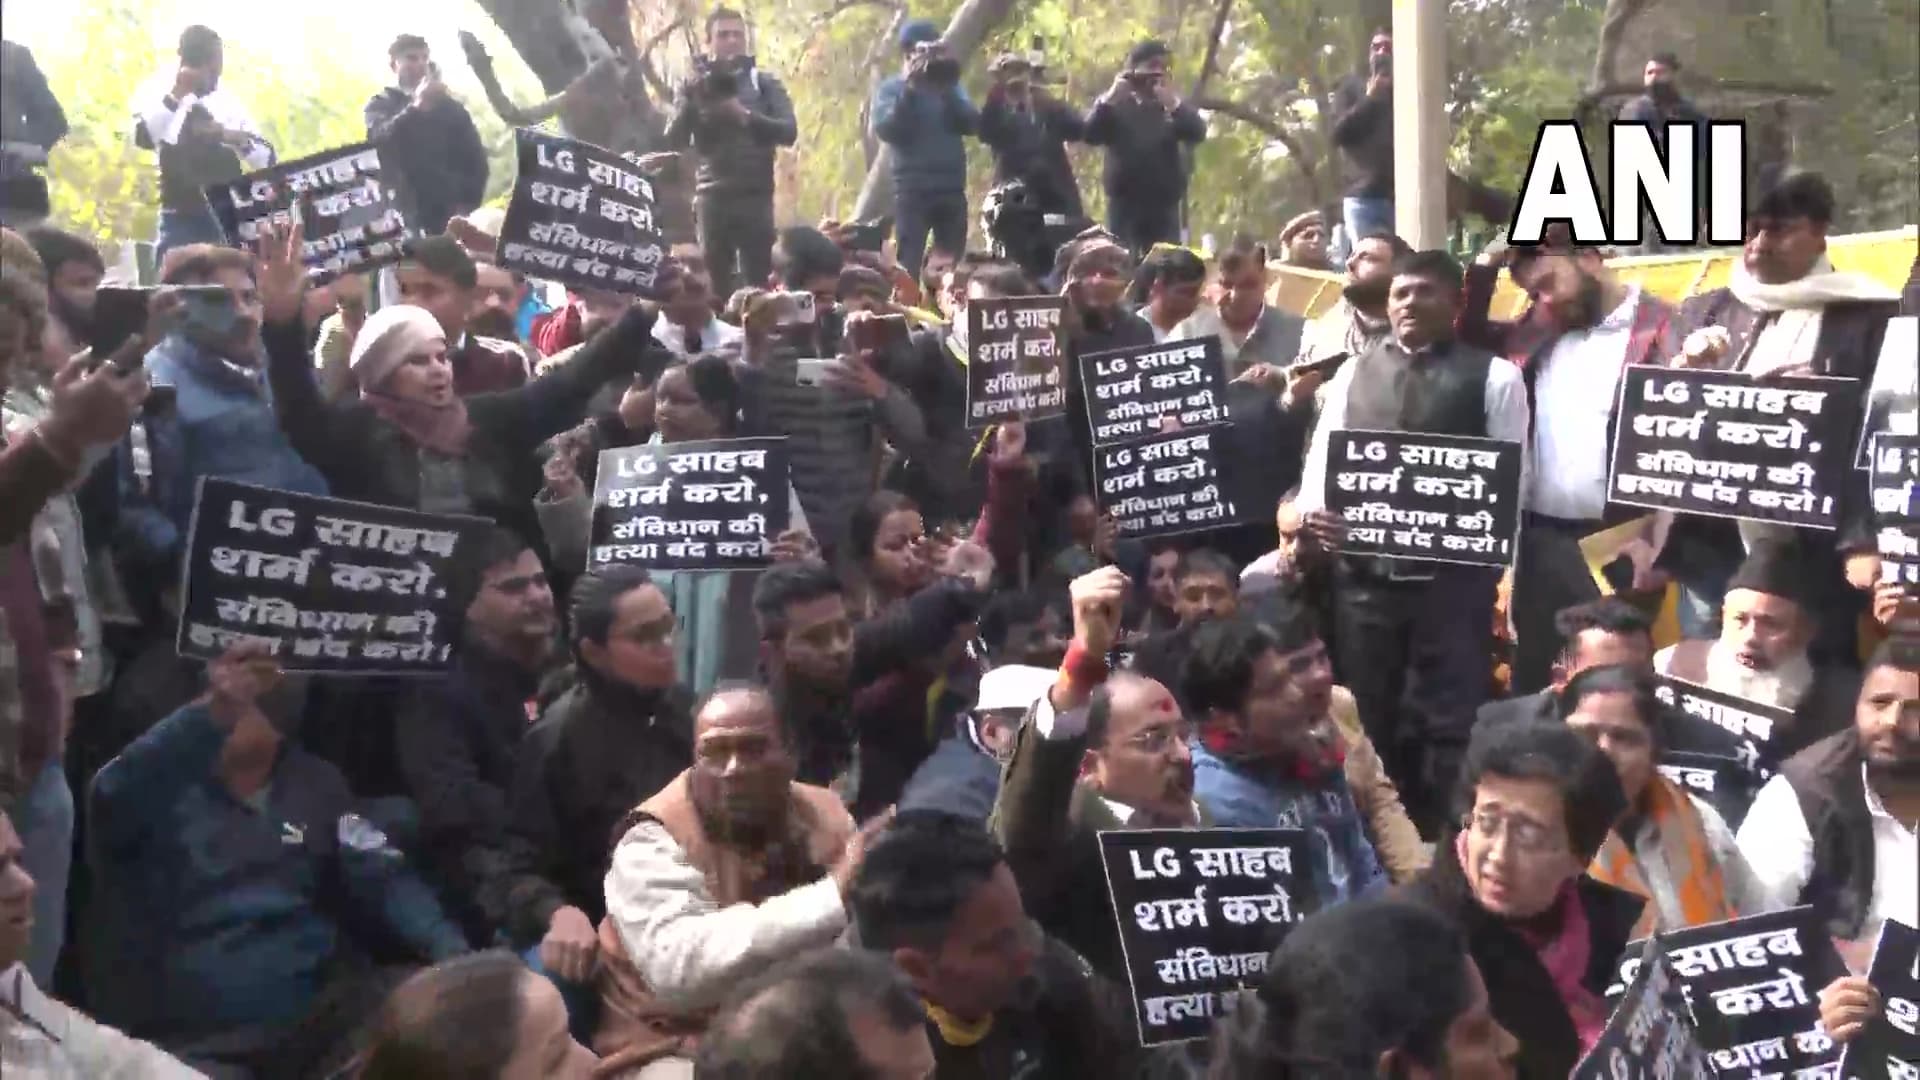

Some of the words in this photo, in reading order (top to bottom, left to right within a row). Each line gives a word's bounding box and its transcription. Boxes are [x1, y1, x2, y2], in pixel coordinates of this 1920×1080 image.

[537, 144, 576, 174] LG
[586, 158, 655, 203] साहब
[531, 182, 593, 214] शर्म
[981, 309, 1008, 331] LG
[1013, 308, 1061, 328] साहब
[978, 333, 1019, 362] शर्म
[1095, 358, 1128, 376] LG
[1134, 344, 1206, 369] साहब
[1096, 373, 1142, 399] शर्म
[1643, 379, 1690, 404] LG
[1702, 384, 1828, 414] साहब
[1106, 398, 1182, 420] संविधान
[1187, 389, 1213, 406] की
[1633, 410, 1709, 440] शर्म
[617, 455, 657, 477] LG
[668, 450, 767, 473] साहब
[1105, 449, 1132, 469] LG
[1138, 434, 1210, 461] साहब
[1347, 441, 1387, 461] LG
[1400, 444, 1501, 470] साहब
[1103, 465, 1146, 493] शर्म
[1337, 466, 1405, 493] शर्म
[1636, 449, 1759, 481] संविधान
[1766, 462, 1815, 487] की
[608, 477, 673, 507] शर्म
[683, 475, 768, 505] करो,
[1110, 493, 1186, 517] संविधान
[1192, 484, 1218, 503] की
[1617, 473, 1685, 497] हत्या
[1691, 479, 1741, 504] बंद
[229, 500, 296, 536] LG
[316, 515, 458, 558] साहब
[613, 516, 721, 539] संविधान
[728, 512, 766, 535] की
[1151, 510, 1180, 526] बंद
[1343, 502, 1449, 527] संविधान
[1455, 510, 1495, 532] की
[595, 543, 658, 562] हत्या
[667, 538, 708, 557] बंद
[1347, 527, 1386, 544] त्या
[1392, 527, 1434, 548] बंद
[211, 547, 320, 586] शर्म
[1681, 694, 1774, 741] साहब
[1130, 847, 1181, 880] LG
[1190, 847, 1292, 878] साहब
[1134, 885, 1209, 931] शर्म
[1155, 947, 1270, 984] संविधान
[1668, 928, 1802, 977] साहब
[1142, 992, 1213, 1026] हत्या
